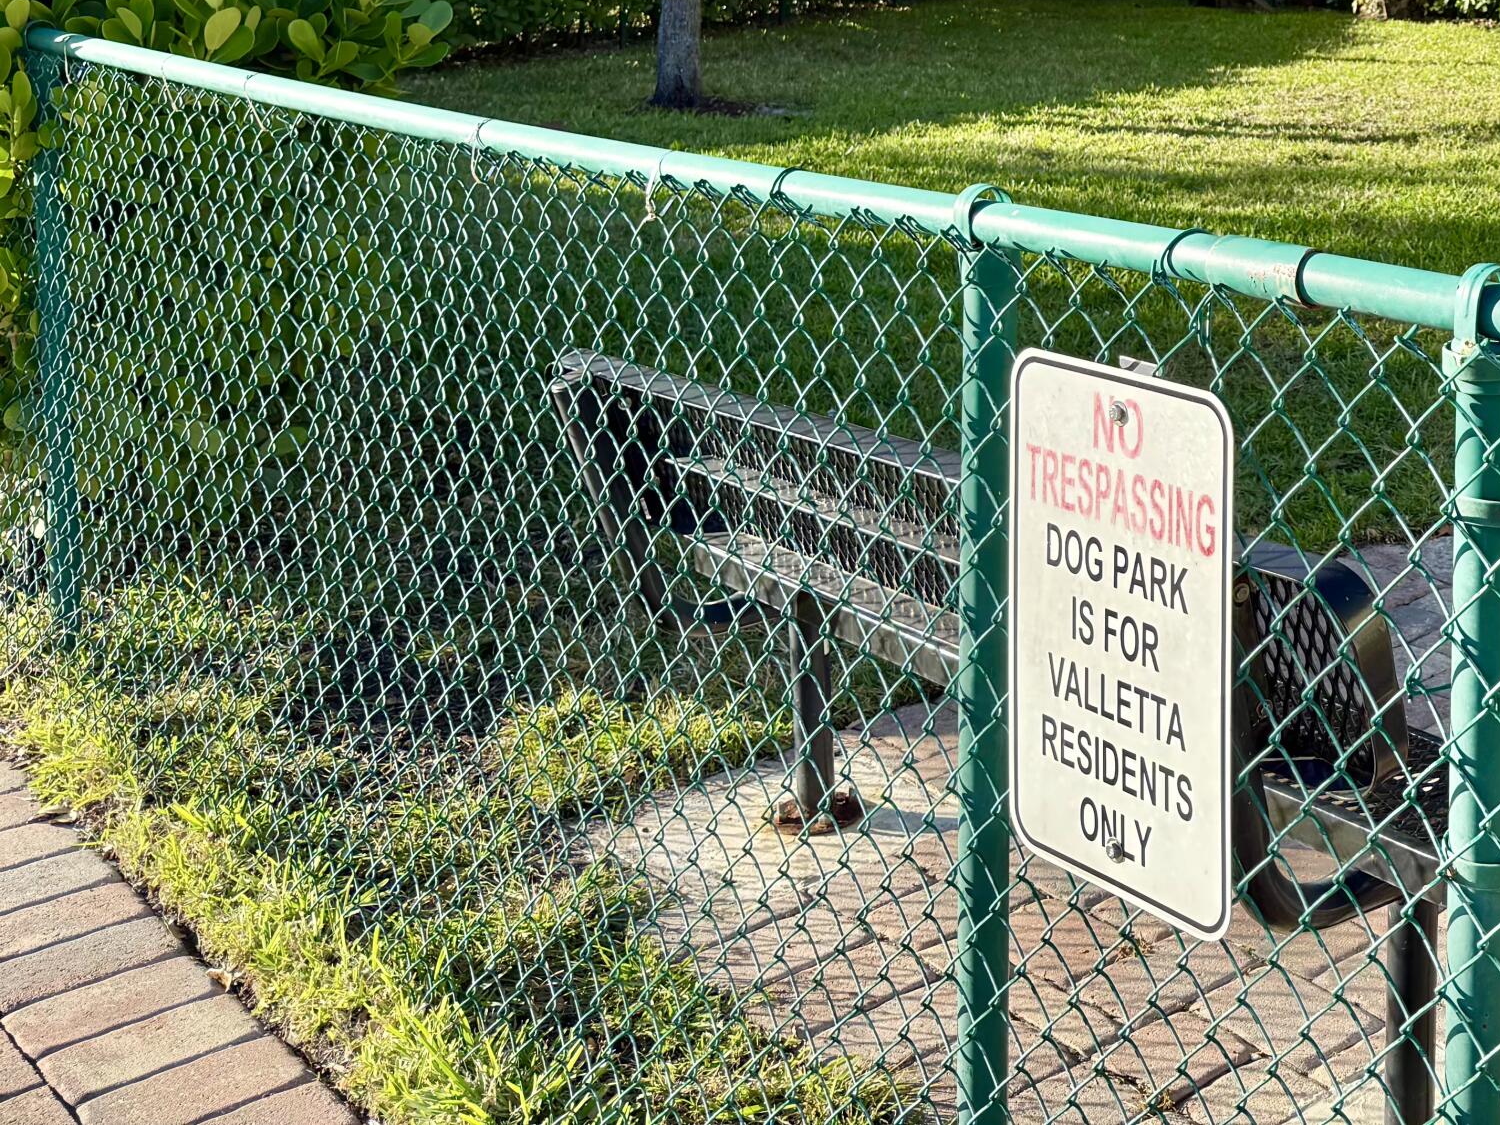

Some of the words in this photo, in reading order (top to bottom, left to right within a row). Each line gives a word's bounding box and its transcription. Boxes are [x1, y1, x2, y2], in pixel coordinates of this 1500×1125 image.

[1093, 392, 1144, 459] NO
[1026, 442, 1216, 557] TRESPASSING
[1046, 522, 1103, 582] DOG
[1113, 544, 1188, 615] PARK
[1072, 595, 1095, 646] IS
[1104, 607, 1160, 673] FOR
[1048, 651, 1187, 753] VALLETTA
[1042, 713, 1194, 822] RESIDENTS
[1080, 796, 1153, 868] ONLY
